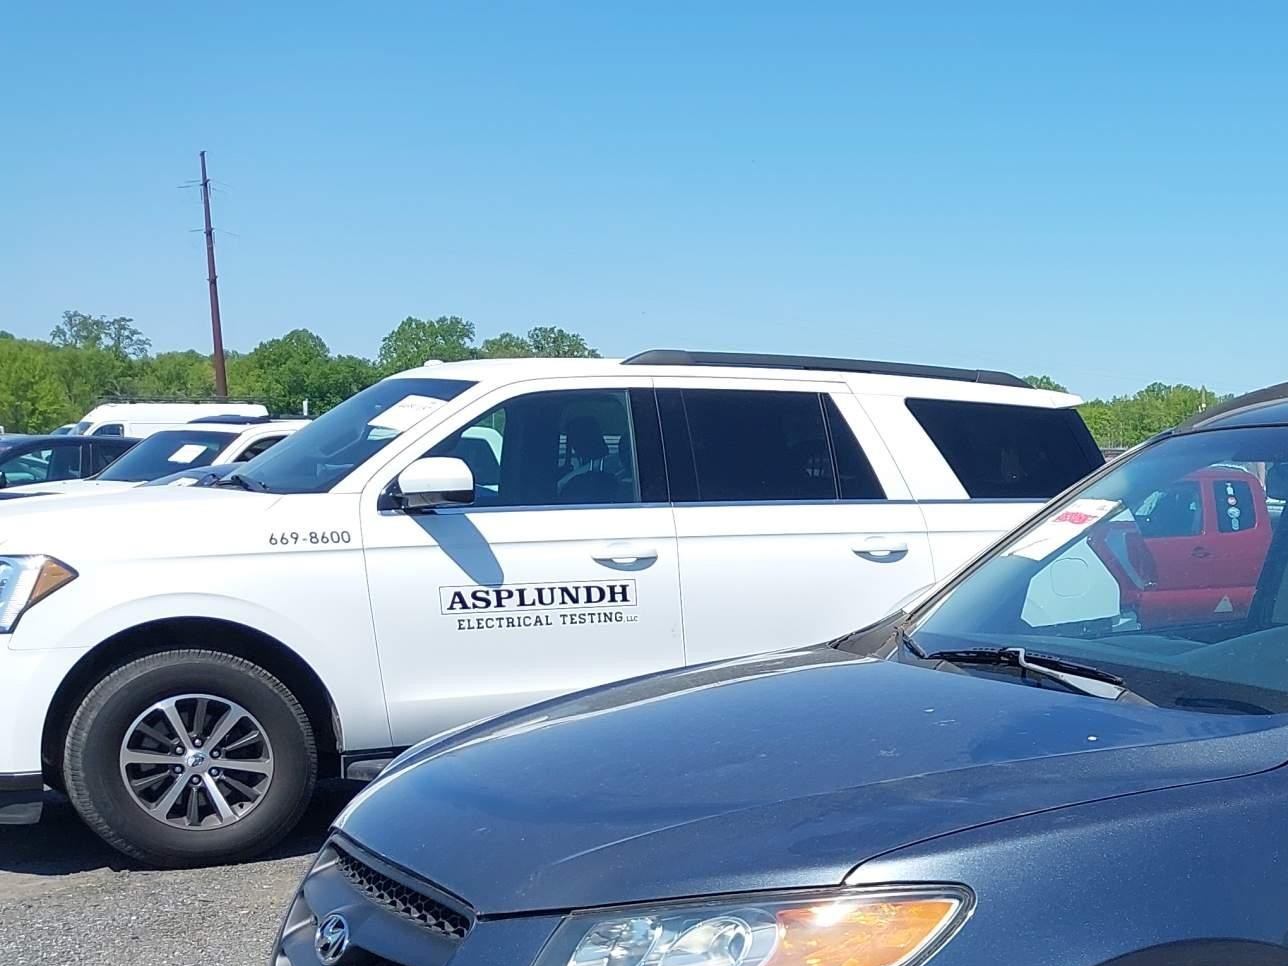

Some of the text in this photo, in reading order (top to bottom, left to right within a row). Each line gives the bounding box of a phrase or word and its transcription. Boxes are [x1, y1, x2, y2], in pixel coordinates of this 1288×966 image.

[268, 530, 351, 546] 669-8600
[446, 583, 630, 610] ASPLUNDH
[456, 613, 553, 631] ELECTRICAL
[626, 615, 638, 624] LLC
